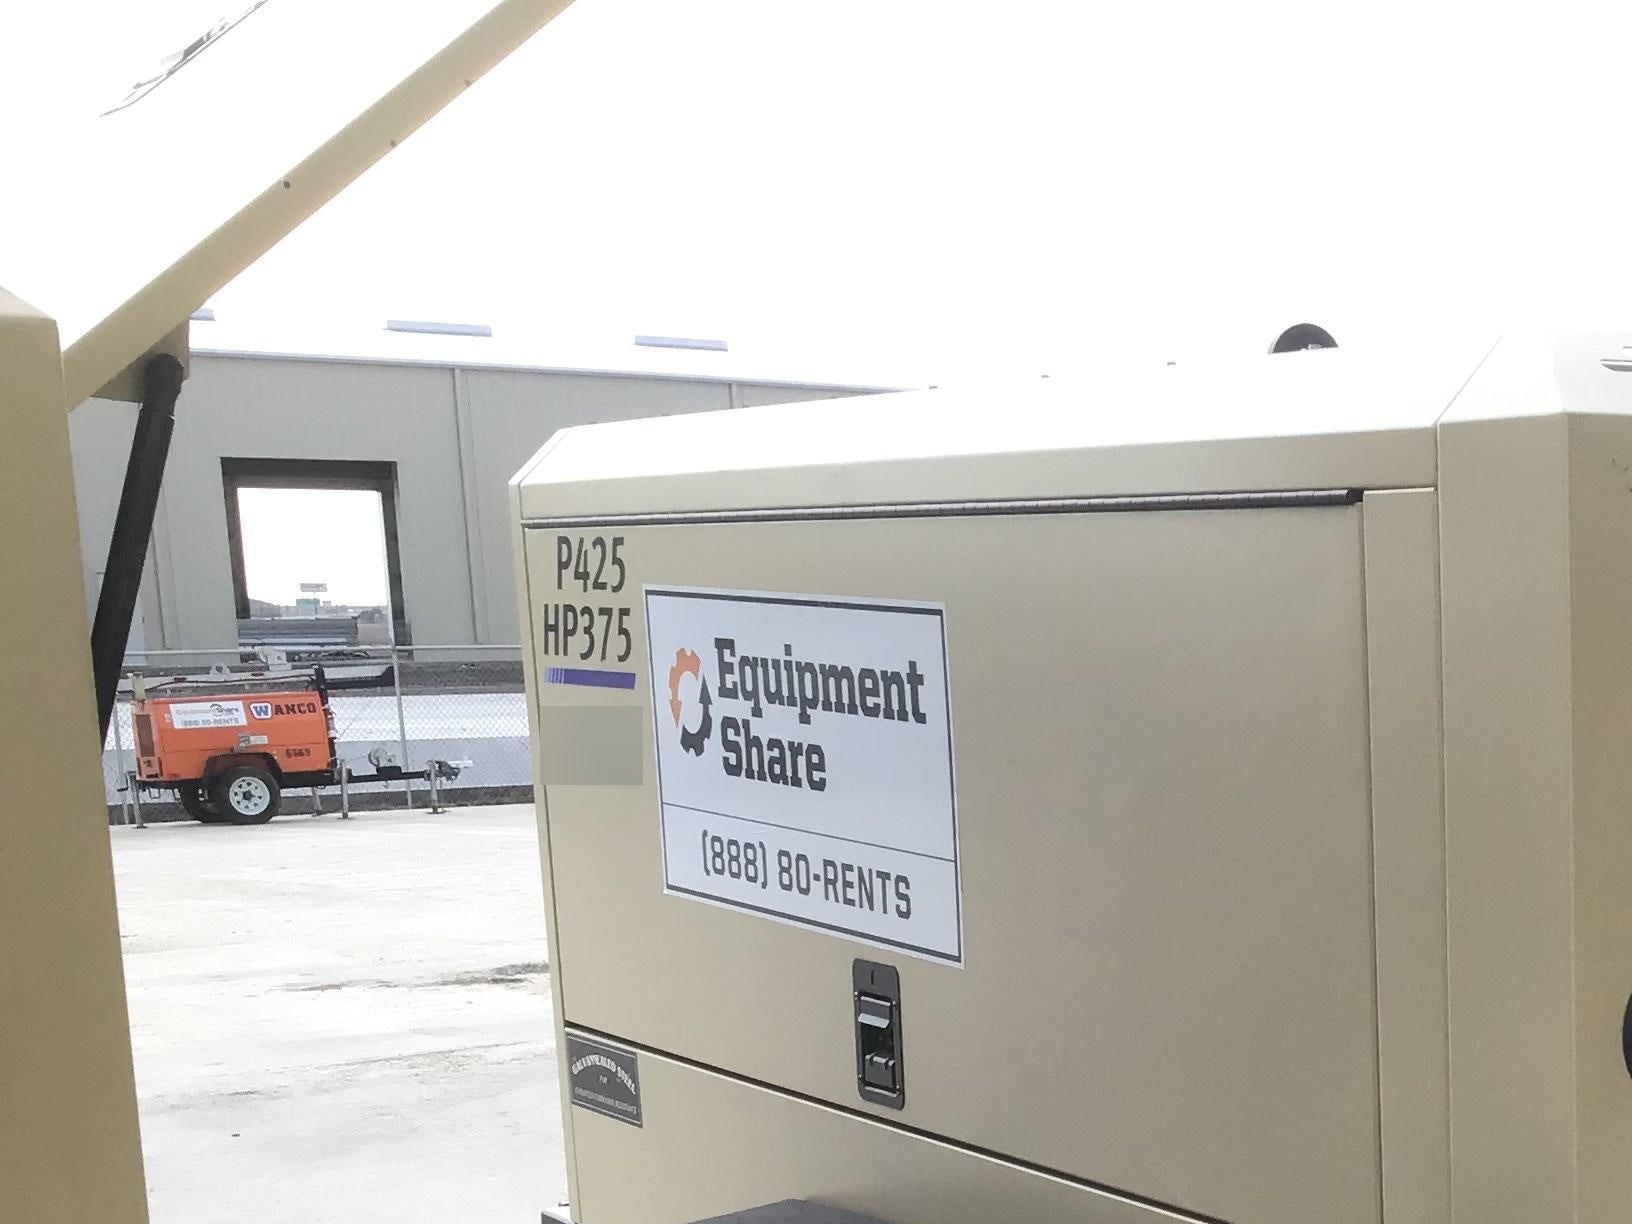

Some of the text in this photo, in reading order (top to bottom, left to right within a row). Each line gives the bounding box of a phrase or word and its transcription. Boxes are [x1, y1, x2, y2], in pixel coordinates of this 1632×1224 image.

[557, 536, 626, 593] P425
[543, 603, 632, 662] HP375
[252, 703, 316, 718] WANCO
[714, 637, 926, 725] Equipment
[721, 716, 827, 791] Share
[701, 829, 911, 919] (888) 80-RENTS
